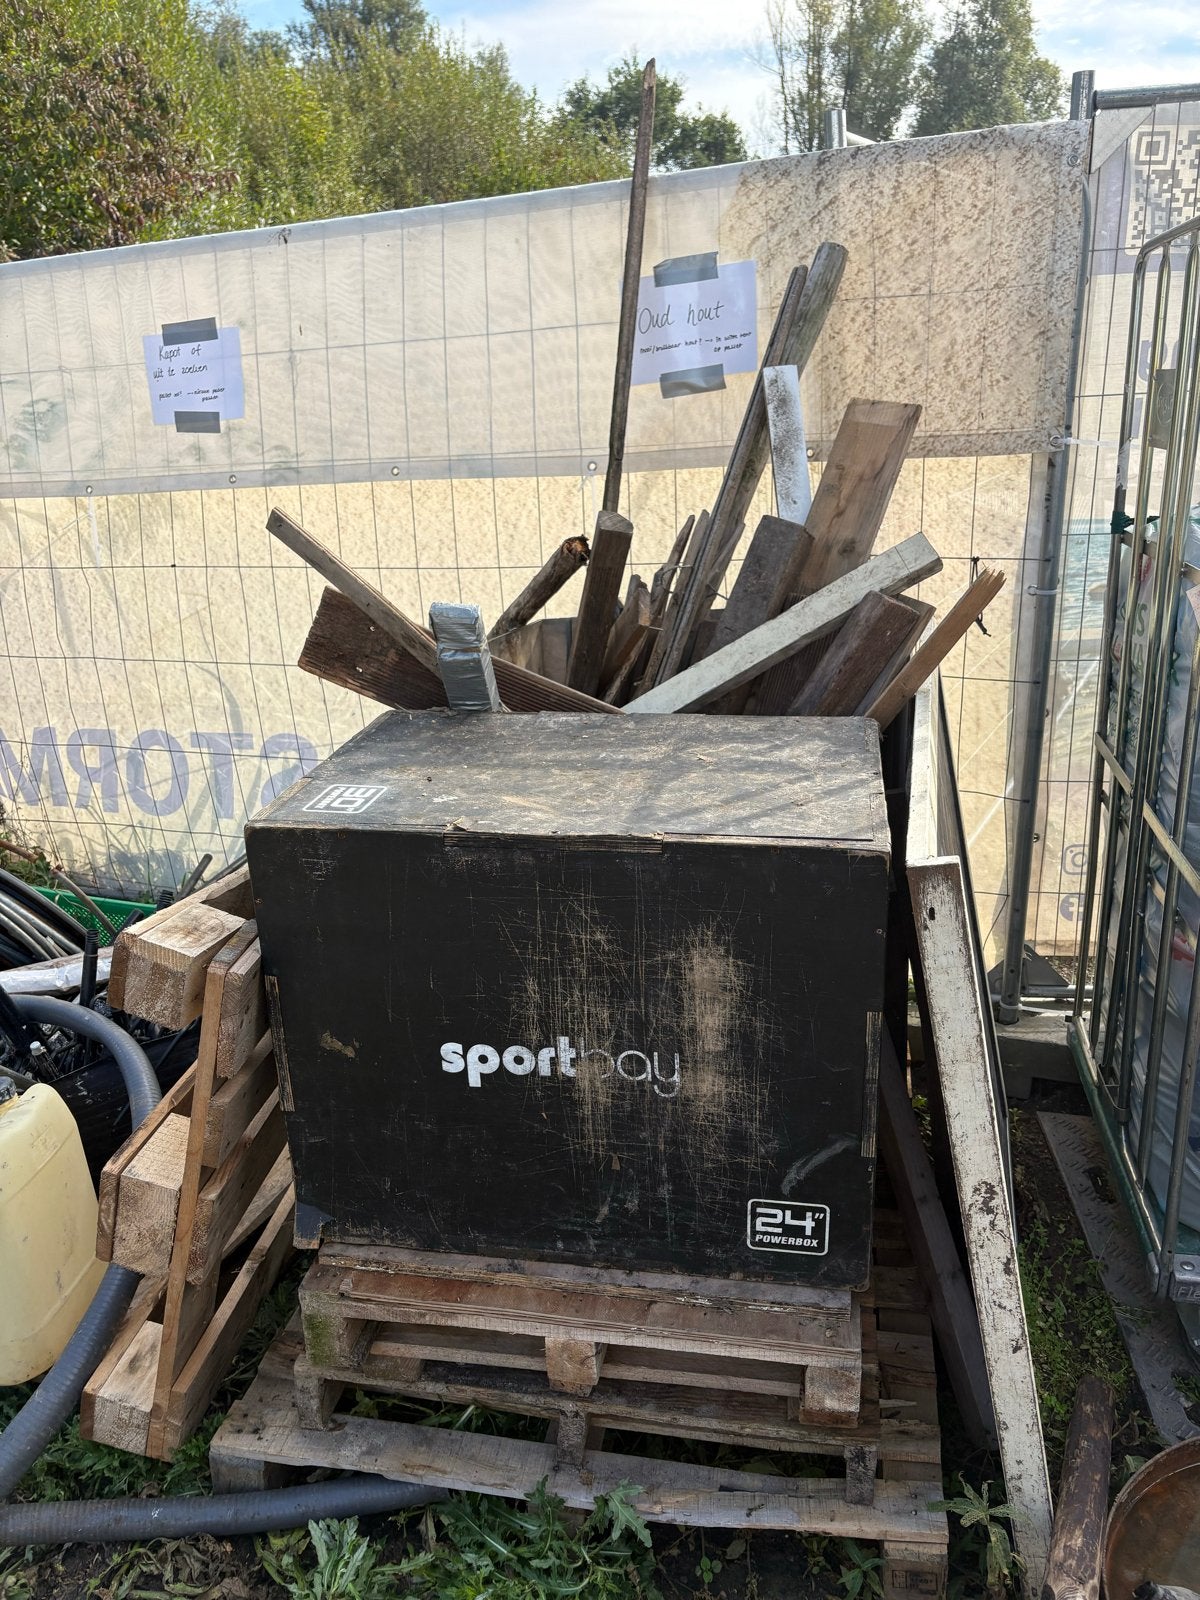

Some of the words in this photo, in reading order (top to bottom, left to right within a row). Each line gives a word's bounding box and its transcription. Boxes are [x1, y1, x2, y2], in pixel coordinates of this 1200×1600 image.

[638, 304, 674, 334] Oud
[687, 301, 725, 326] hout
[159, 345, 181, 362] Kapot
[191, 344, 202, 356] of
[153, 367, 164, 379] uit
[168, 366, 176, 376] te
[182, 364, 208, 374] zoeken
[755, 1207, 825, 1236] 24"
[755, 1234, 819, 1248] POWERBOX
